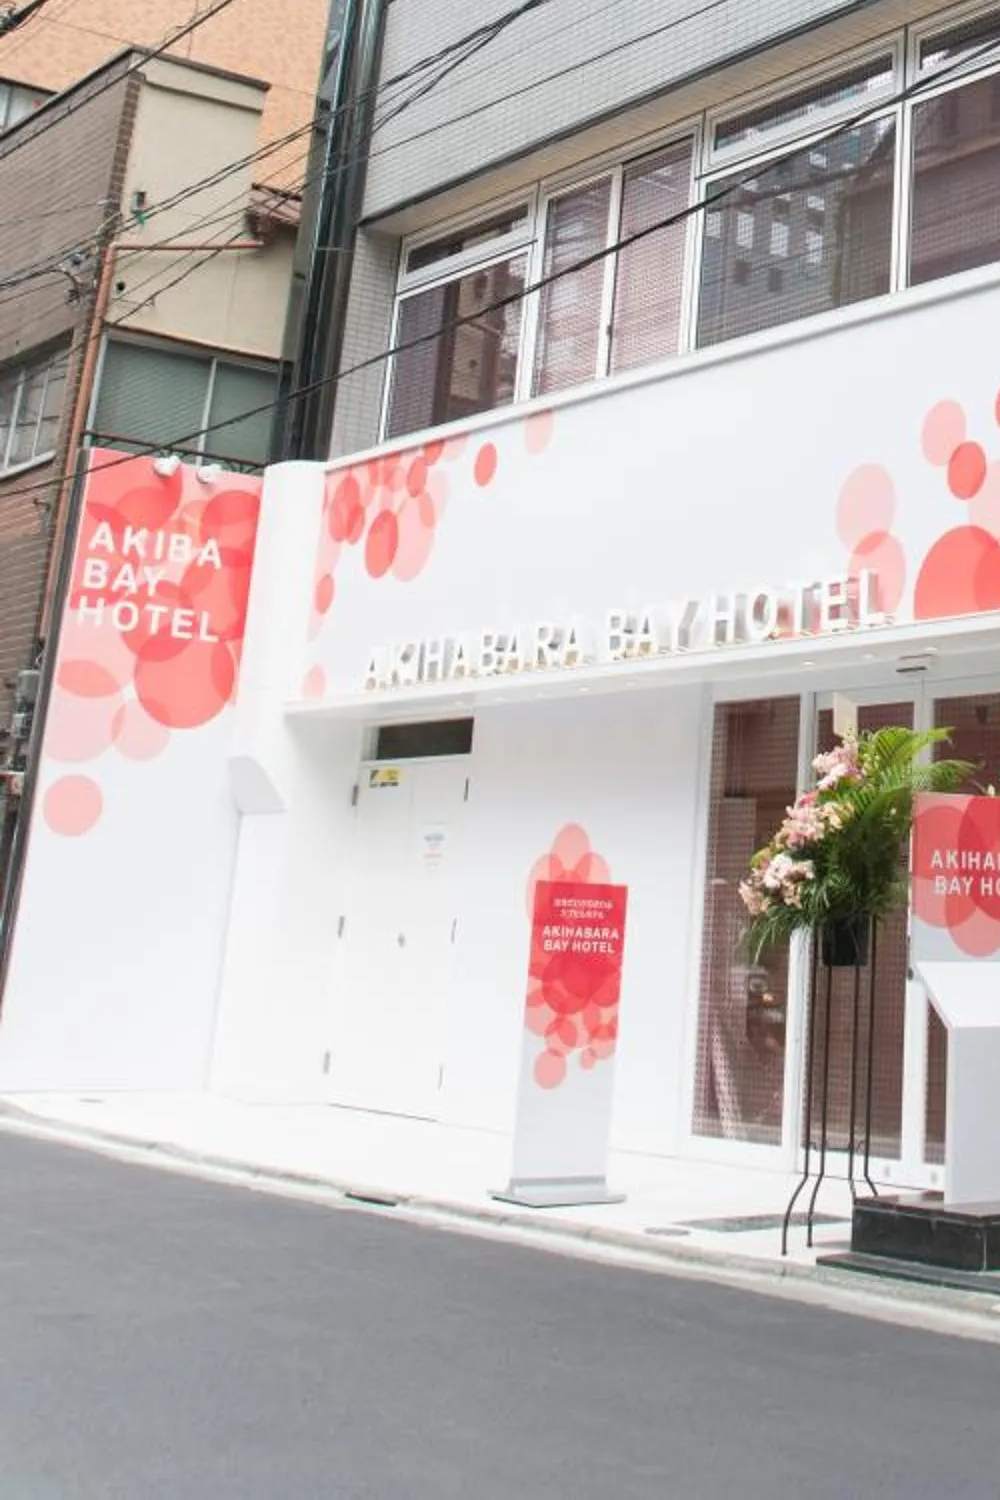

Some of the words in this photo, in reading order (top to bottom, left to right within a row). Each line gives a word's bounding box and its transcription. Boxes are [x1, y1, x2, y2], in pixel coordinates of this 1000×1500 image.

[89, 520, 222, 570] AKIBA
[82, 557, 167, 597] BAY
[77, 595, 219, 643] HOTEL
[364, 617, 588, 691] AKIHABARA
[606, 598, 698, 660] BAY
[708, 567, 890, 647] HOTEL
[934, 874, 975, 896] BAY
[543, 924, 620, 940] AKIHABARA
[543, 939, 569, 952] BAY
[571, 941, 615, 954] HOTEL
